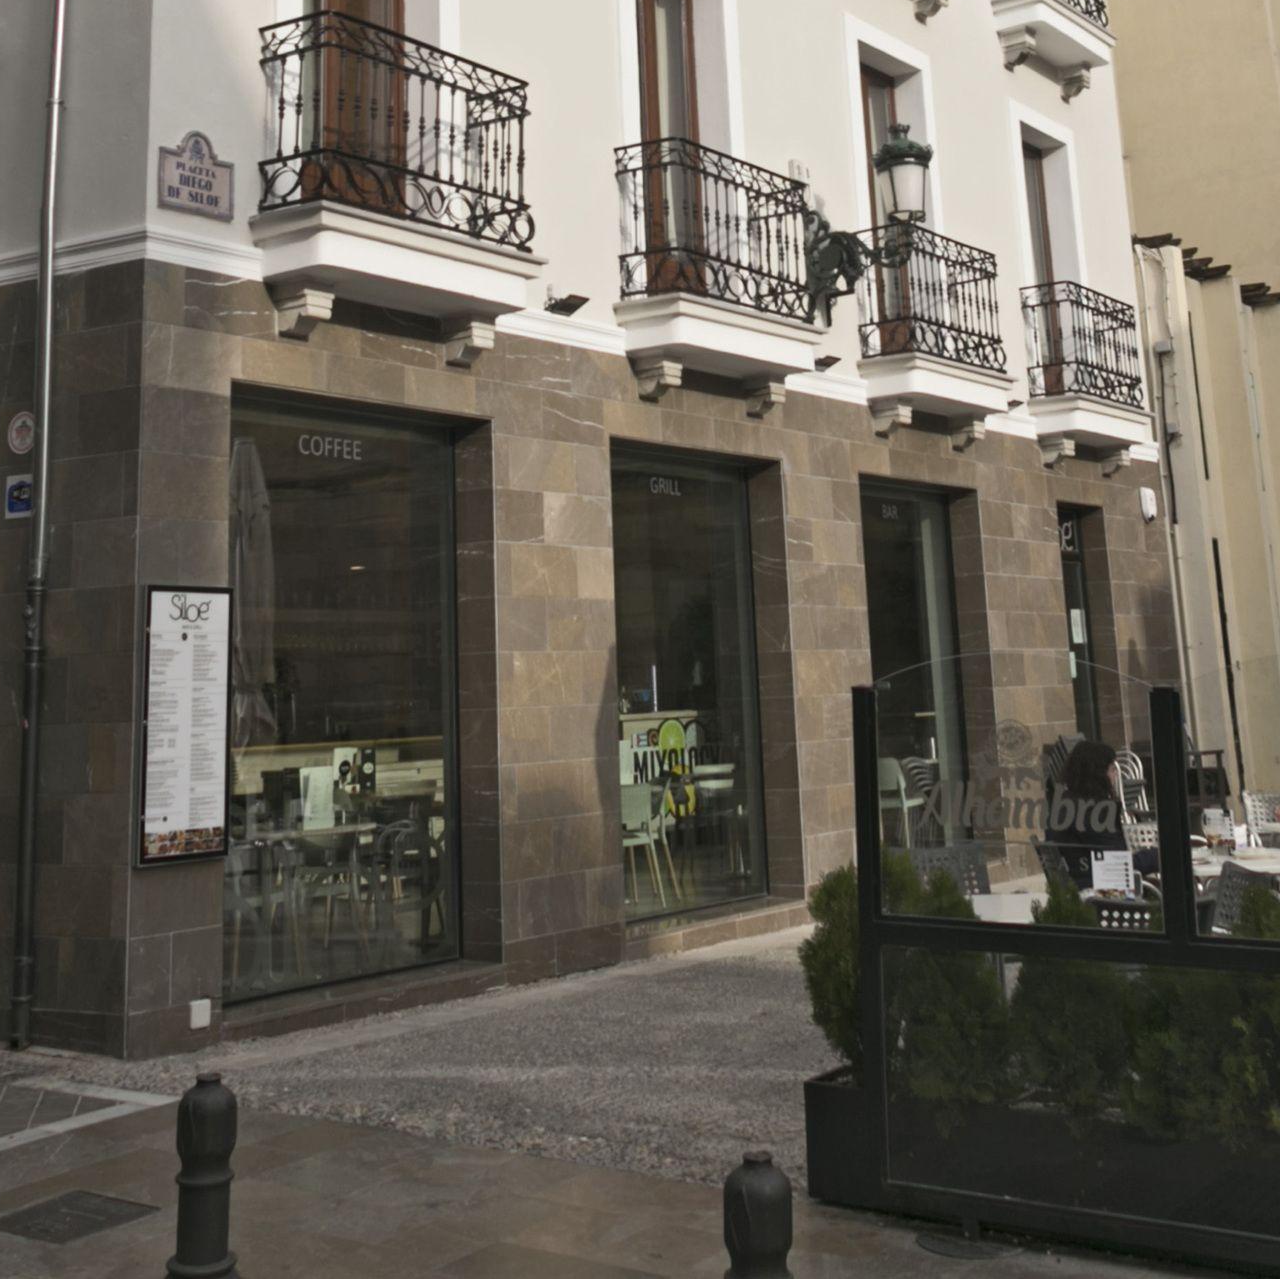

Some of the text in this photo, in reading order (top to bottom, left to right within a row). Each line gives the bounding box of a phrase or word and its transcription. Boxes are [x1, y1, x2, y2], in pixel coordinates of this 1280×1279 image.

[168, 185, 180, 198] DE
[179, 174, 212, 191] DIEGO
[298, 434, 363, 461] COFFEE
[649, 476, 682, 497] GRILL
[880, 503, 900, 521] BAR
[916, 781, 1120, 834] Alhambra
